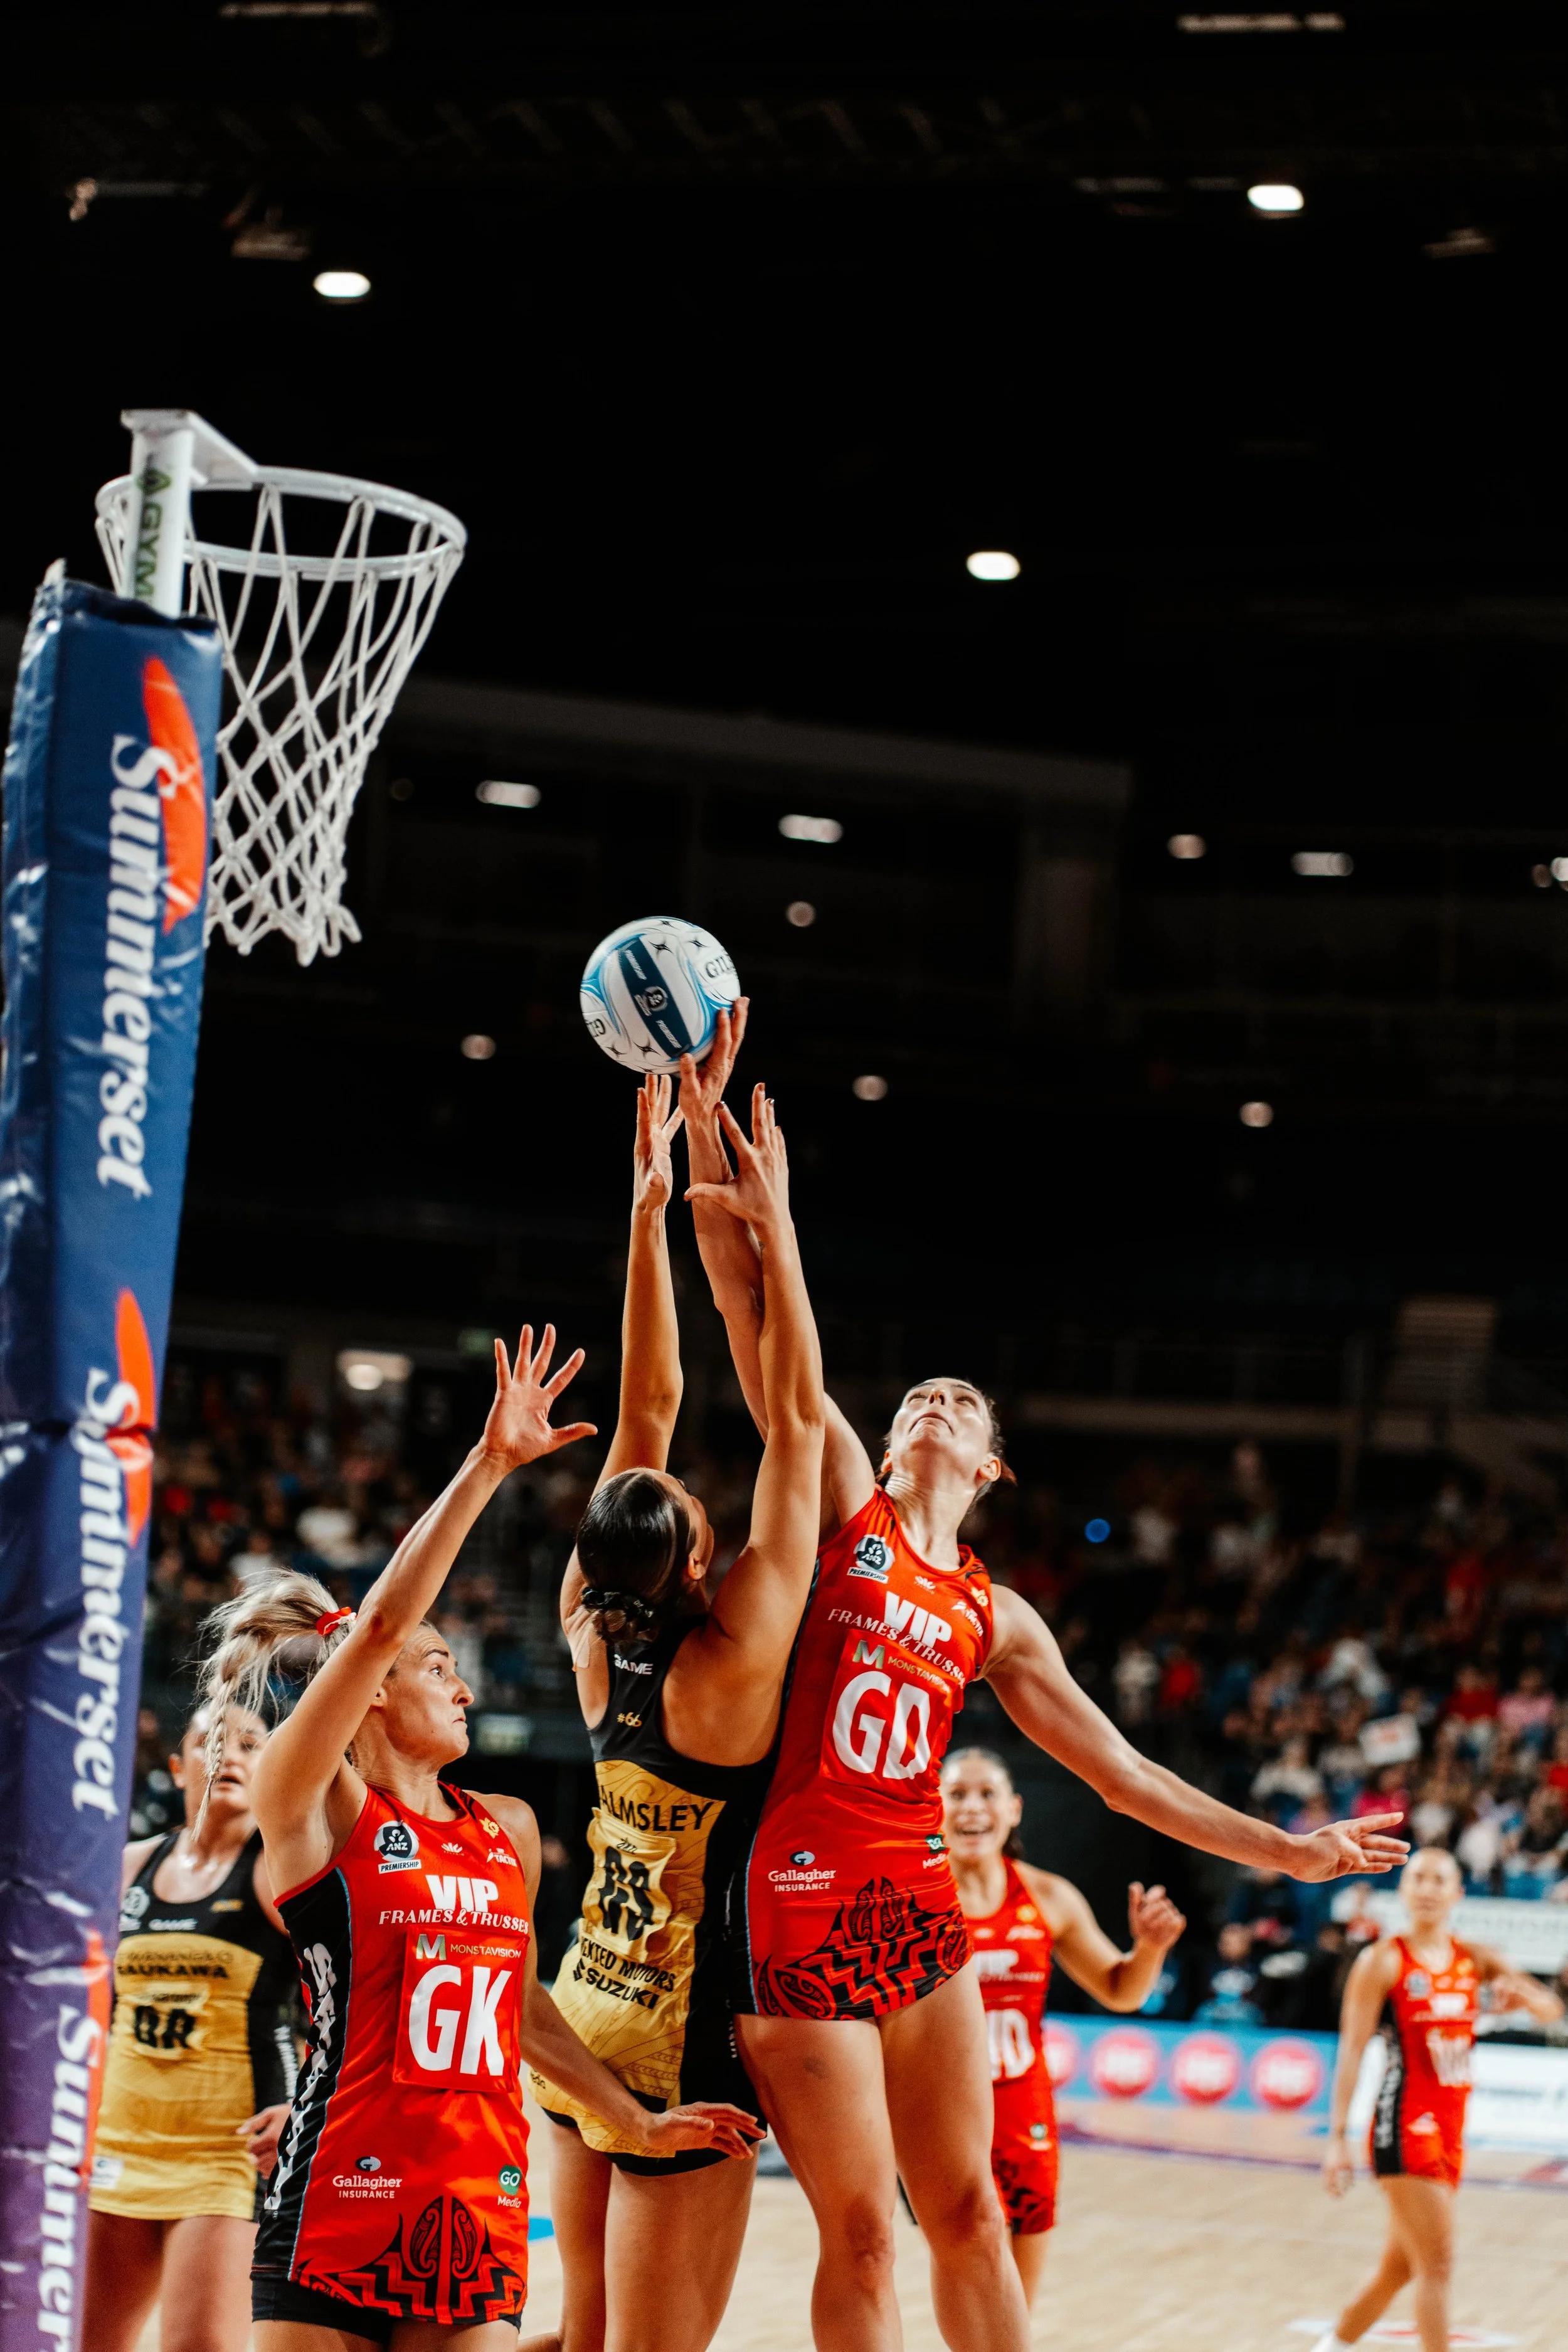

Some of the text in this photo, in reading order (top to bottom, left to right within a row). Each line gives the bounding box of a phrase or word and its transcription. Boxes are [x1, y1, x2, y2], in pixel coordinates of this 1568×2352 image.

[97, 734, 178, 1199] Summerset
[849, 1569, 886, 1581] PREMIERSHIP
[72, 1368, 140, 1820] Summerset
[828, 1608, 899, 1641] FRAMES
[899, 1634, 913, 1651] &
[884, 1591, 952, 1648] VIP
[614, 1654, 654, 1675] GAME
[617, 1712, 642, 1727] #66
[832, 1671, 931, 1780] GD
[599, 1785, 715, 1831] ALMSLEY
[386, 1843, 408, 1851] ANZ
[381, 1861, 420, 1872] PREMIERSHIP
[768, 1869, 836, 1882] Gallagher
[425, 1875, 499, 1912] VIP
[775, 1882, 830, 1892] INSURANCE
[379, 1908, 529, 1935] FRAMES & TRUSSES
[450, 1944, 521, 1958] MONSTAVISION
[582, 1937, 676, 1992] EXTED MOTORS
[586, 1968, 659, 2010] SUZUKI
[409, 1964, 512, 2077] GK
[332, 2175, 402, 2190] Gallagher
[500, 2171, 521, 2187] GO
[339, 2190, 395, 2199] INSURANCE
[497, 2195, 521, 2208] Media
